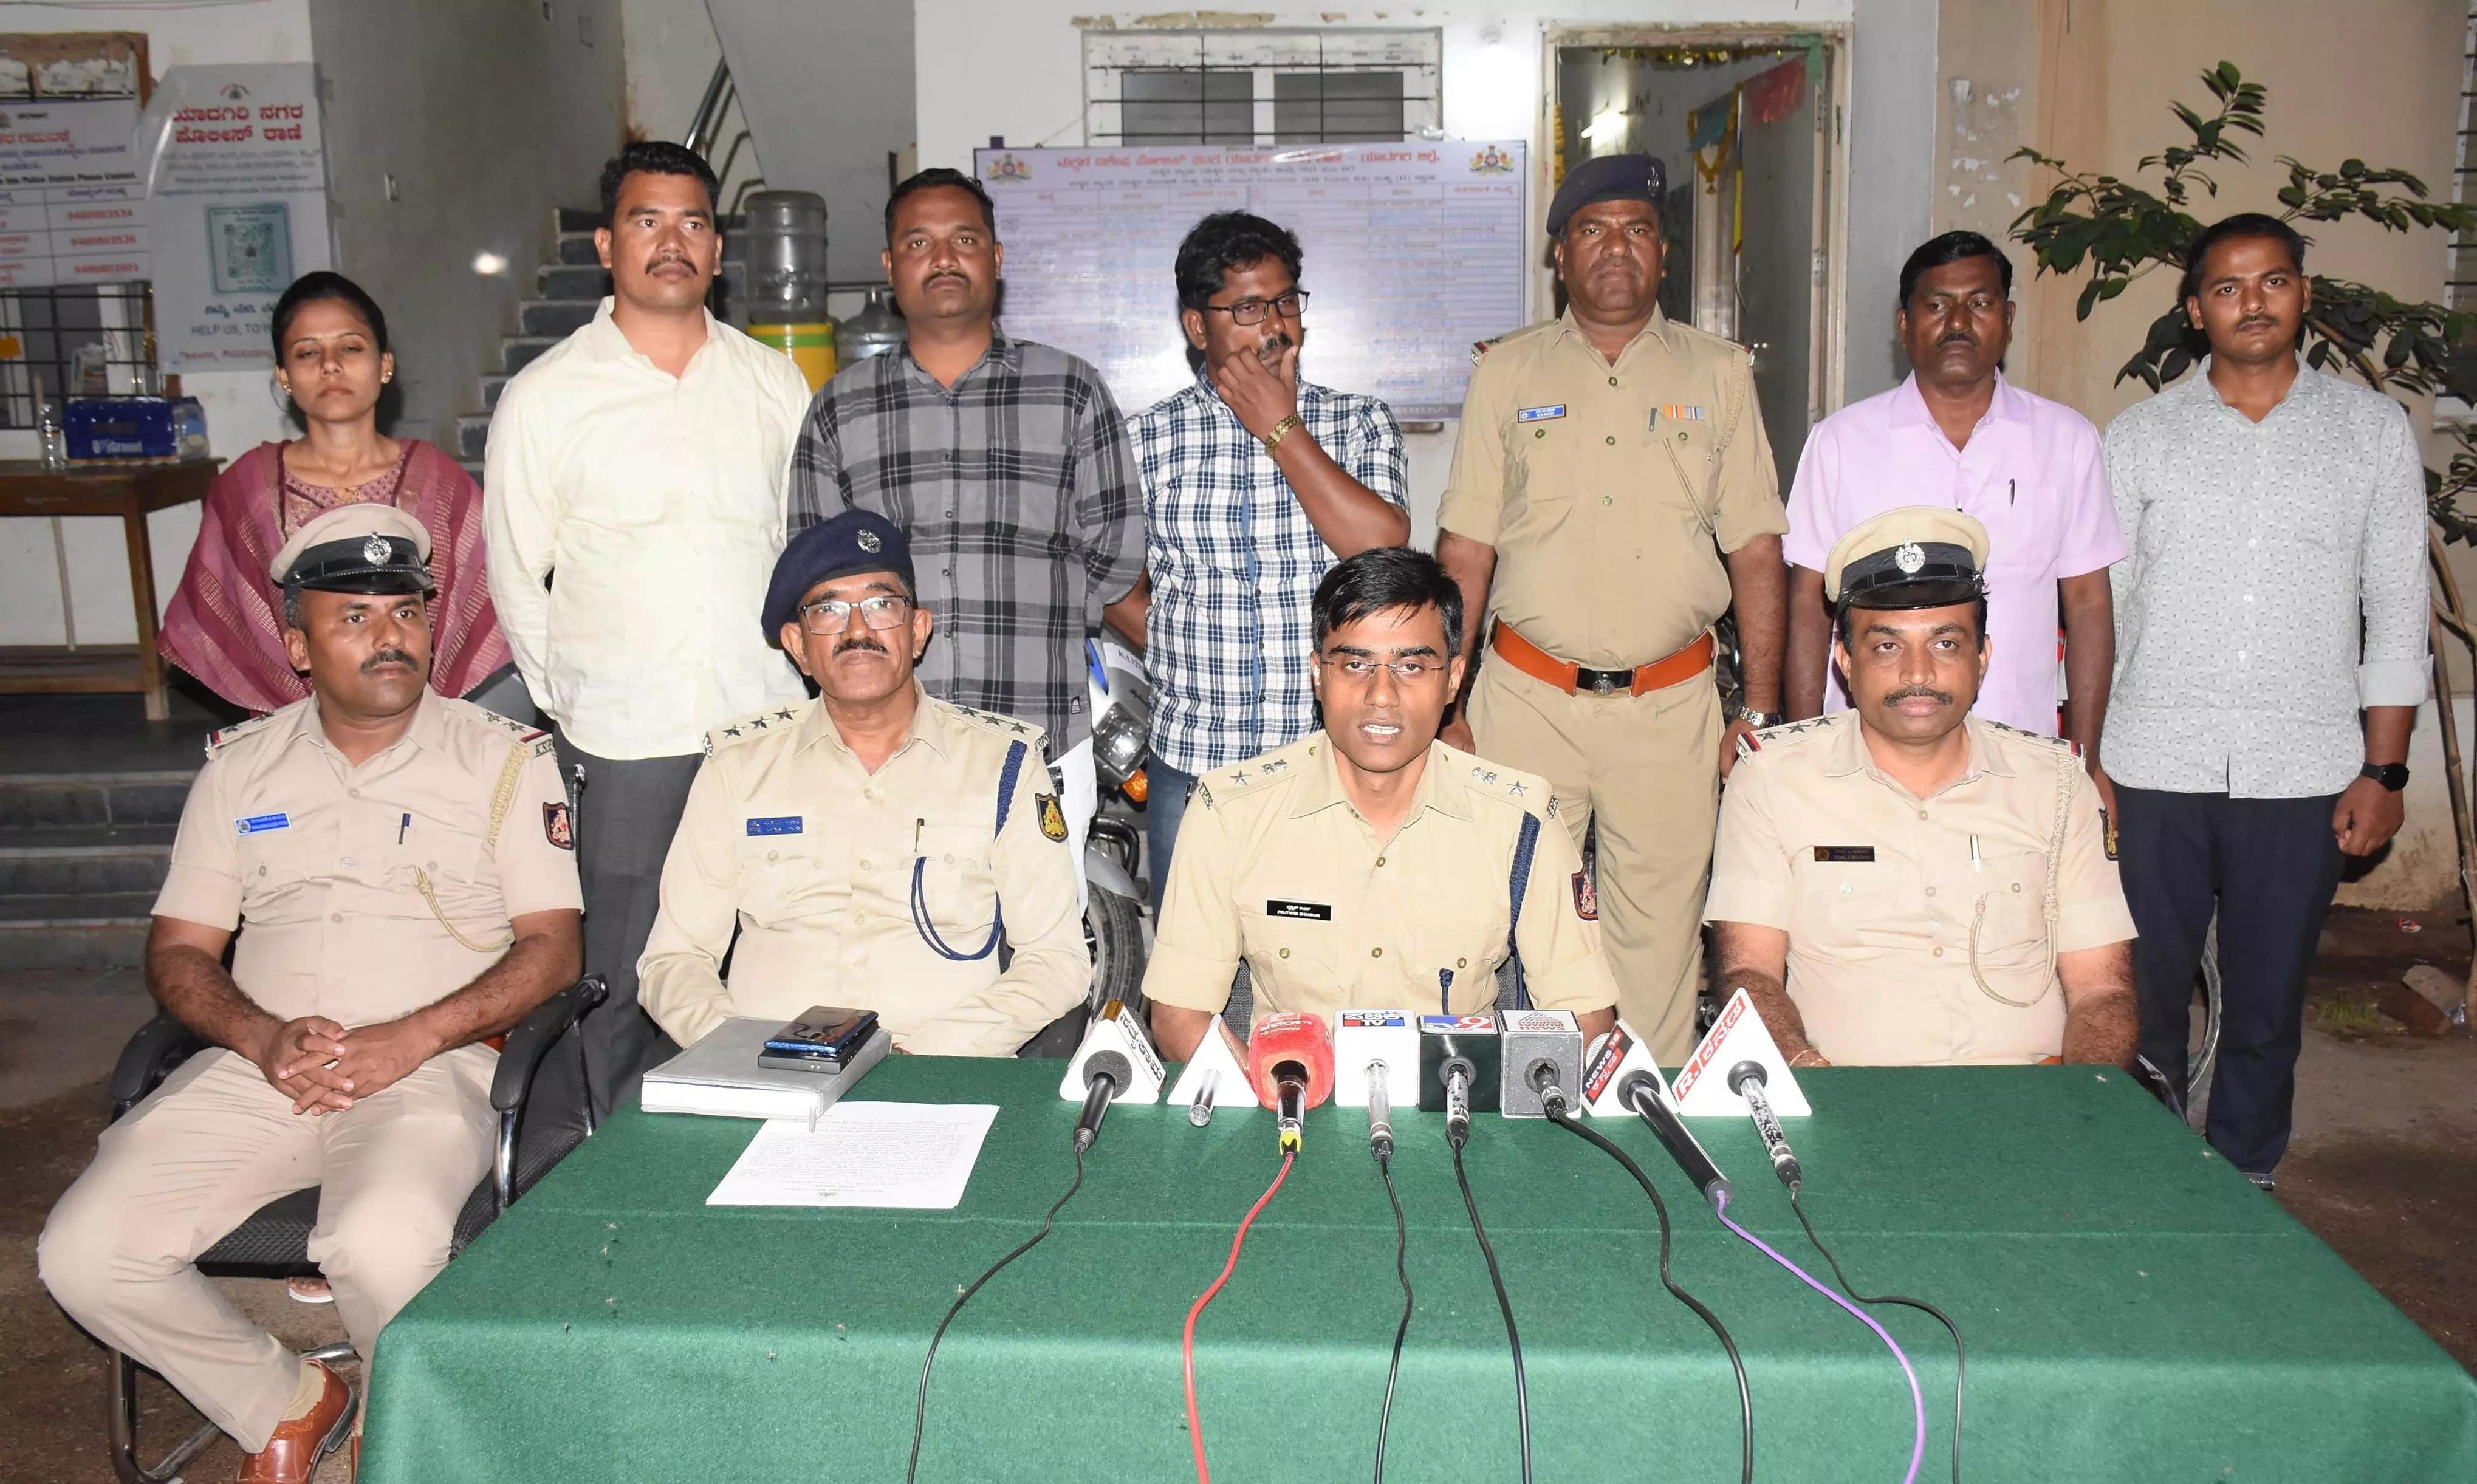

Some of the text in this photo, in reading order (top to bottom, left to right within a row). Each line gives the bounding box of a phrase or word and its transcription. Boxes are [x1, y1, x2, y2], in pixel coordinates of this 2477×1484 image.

[259, 103, 303, 120] ನಗರ
[175, 125, 253, 144] ಪೊಲೀಸ್
[1585, 1049, 1612, 1089] NEWS
